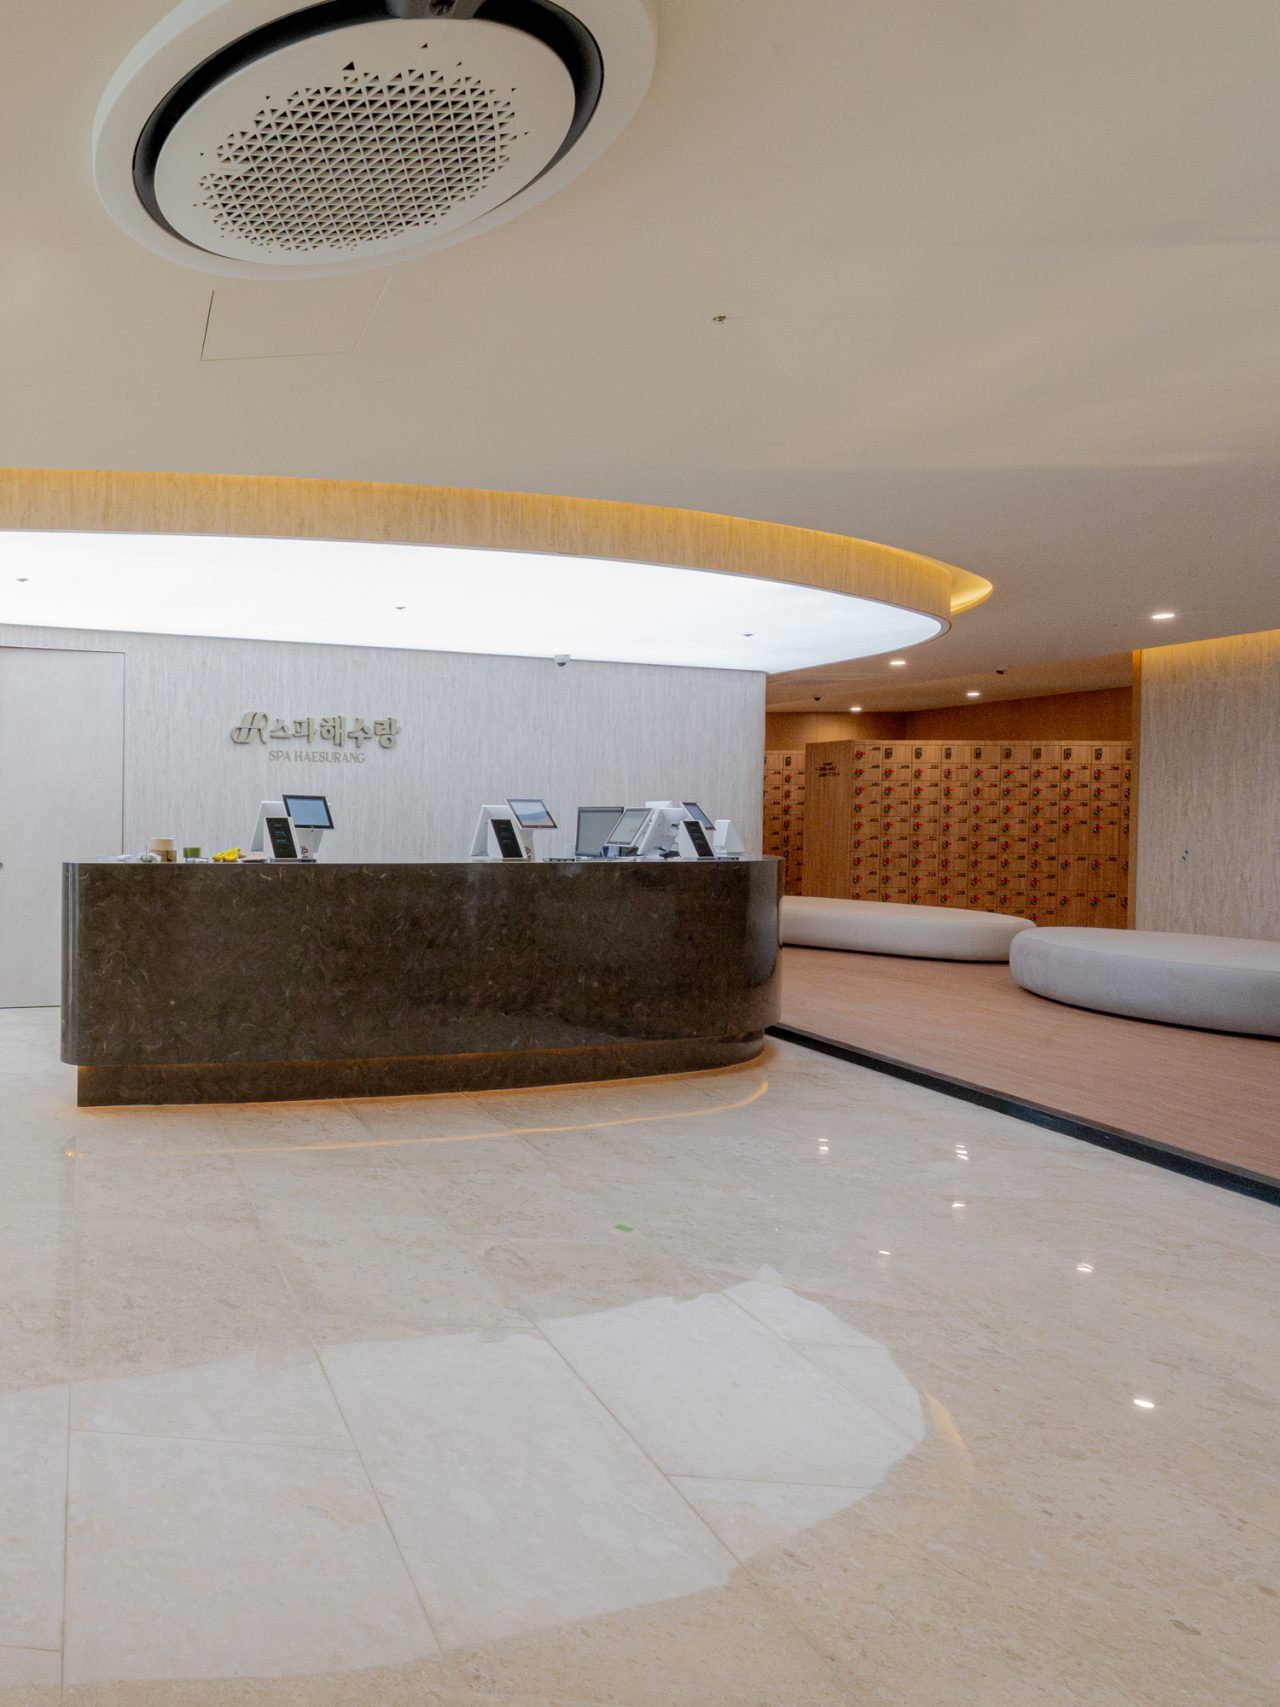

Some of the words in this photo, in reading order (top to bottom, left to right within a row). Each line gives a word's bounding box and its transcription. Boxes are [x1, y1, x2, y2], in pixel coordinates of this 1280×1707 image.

[270, 715, 401, 749] 스파해수랑
[269, 750, 291, 762] SPA
[294, 751, 365, 763] HAESURANG
